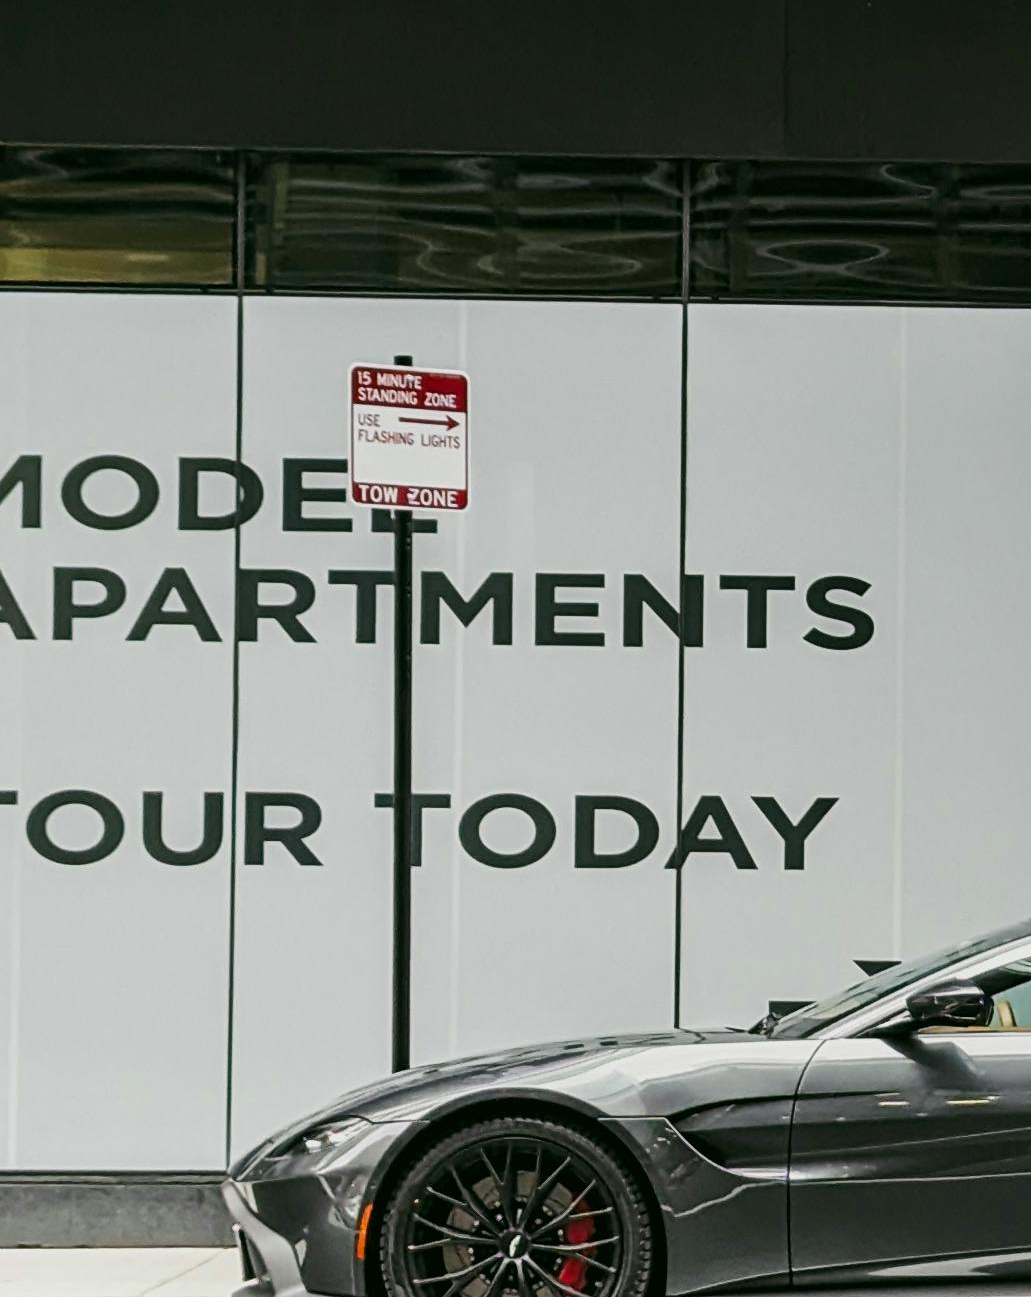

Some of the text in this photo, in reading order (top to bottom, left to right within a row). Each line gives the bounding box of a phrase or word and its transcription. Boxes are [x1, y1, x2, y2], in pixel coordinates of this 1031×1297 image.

[357, 370, 372, 386] 15
[376, 372, 422, 390] MINUTE
[358, 386, 457, 409] STANDING ZONE
[358, 413, 380, 427] USE
[358, 429, 461, 449] FLASHING LIGHTS
[358, 484, 459, 508] TOW ZONE
[0, 789, 840, 871] OUR TODAY
